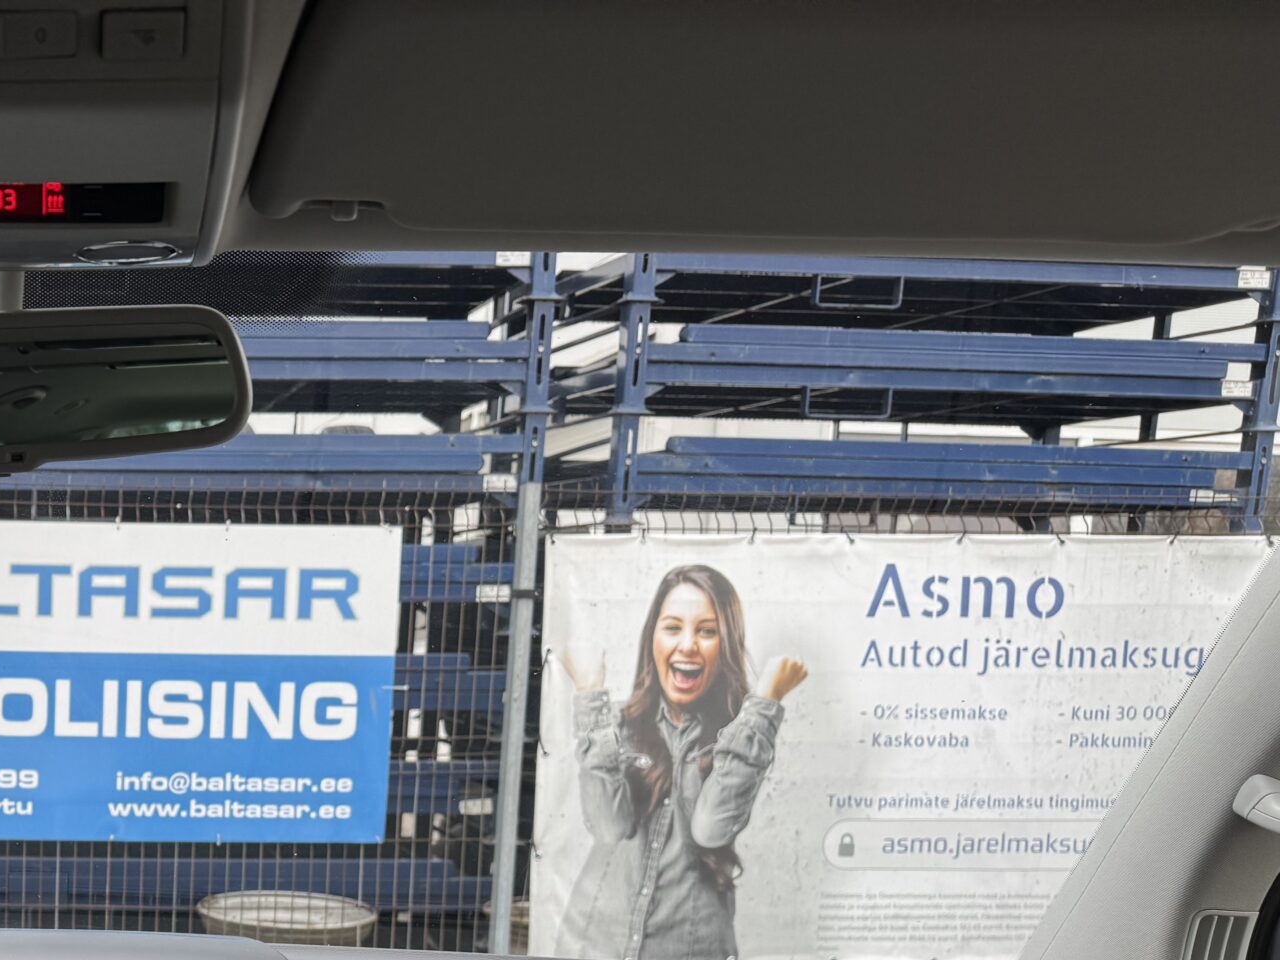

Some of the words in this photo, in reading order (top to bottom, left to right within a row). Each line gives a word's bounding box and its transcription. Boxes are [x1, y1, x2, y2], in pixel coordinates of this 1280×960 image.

[866, 563, 1065, 619] Asmo
[861, 638, 968, 668] Autod
[977, 637, 1208, 677] järelmaksug
[873, 704, 899, 721] 0%
[905, 704, 1008, 721] sissemakse
[1072, 704, 1110, 720] Kuni
[1116, 705, 1137, 720] 30
[871, 732, 970, 748] Kaskovaba
[1069, 732, 1153, 748] Pakkumin
[115, 771, 353, 795] info@baltasar.ee
[108, 799, 351, 819] www.baltasar.ee
[828, 794, 872, 809] Tutvu
[878, 793, 950, 811] parimate
[954, 793, 1043, 811] järelmaksu
